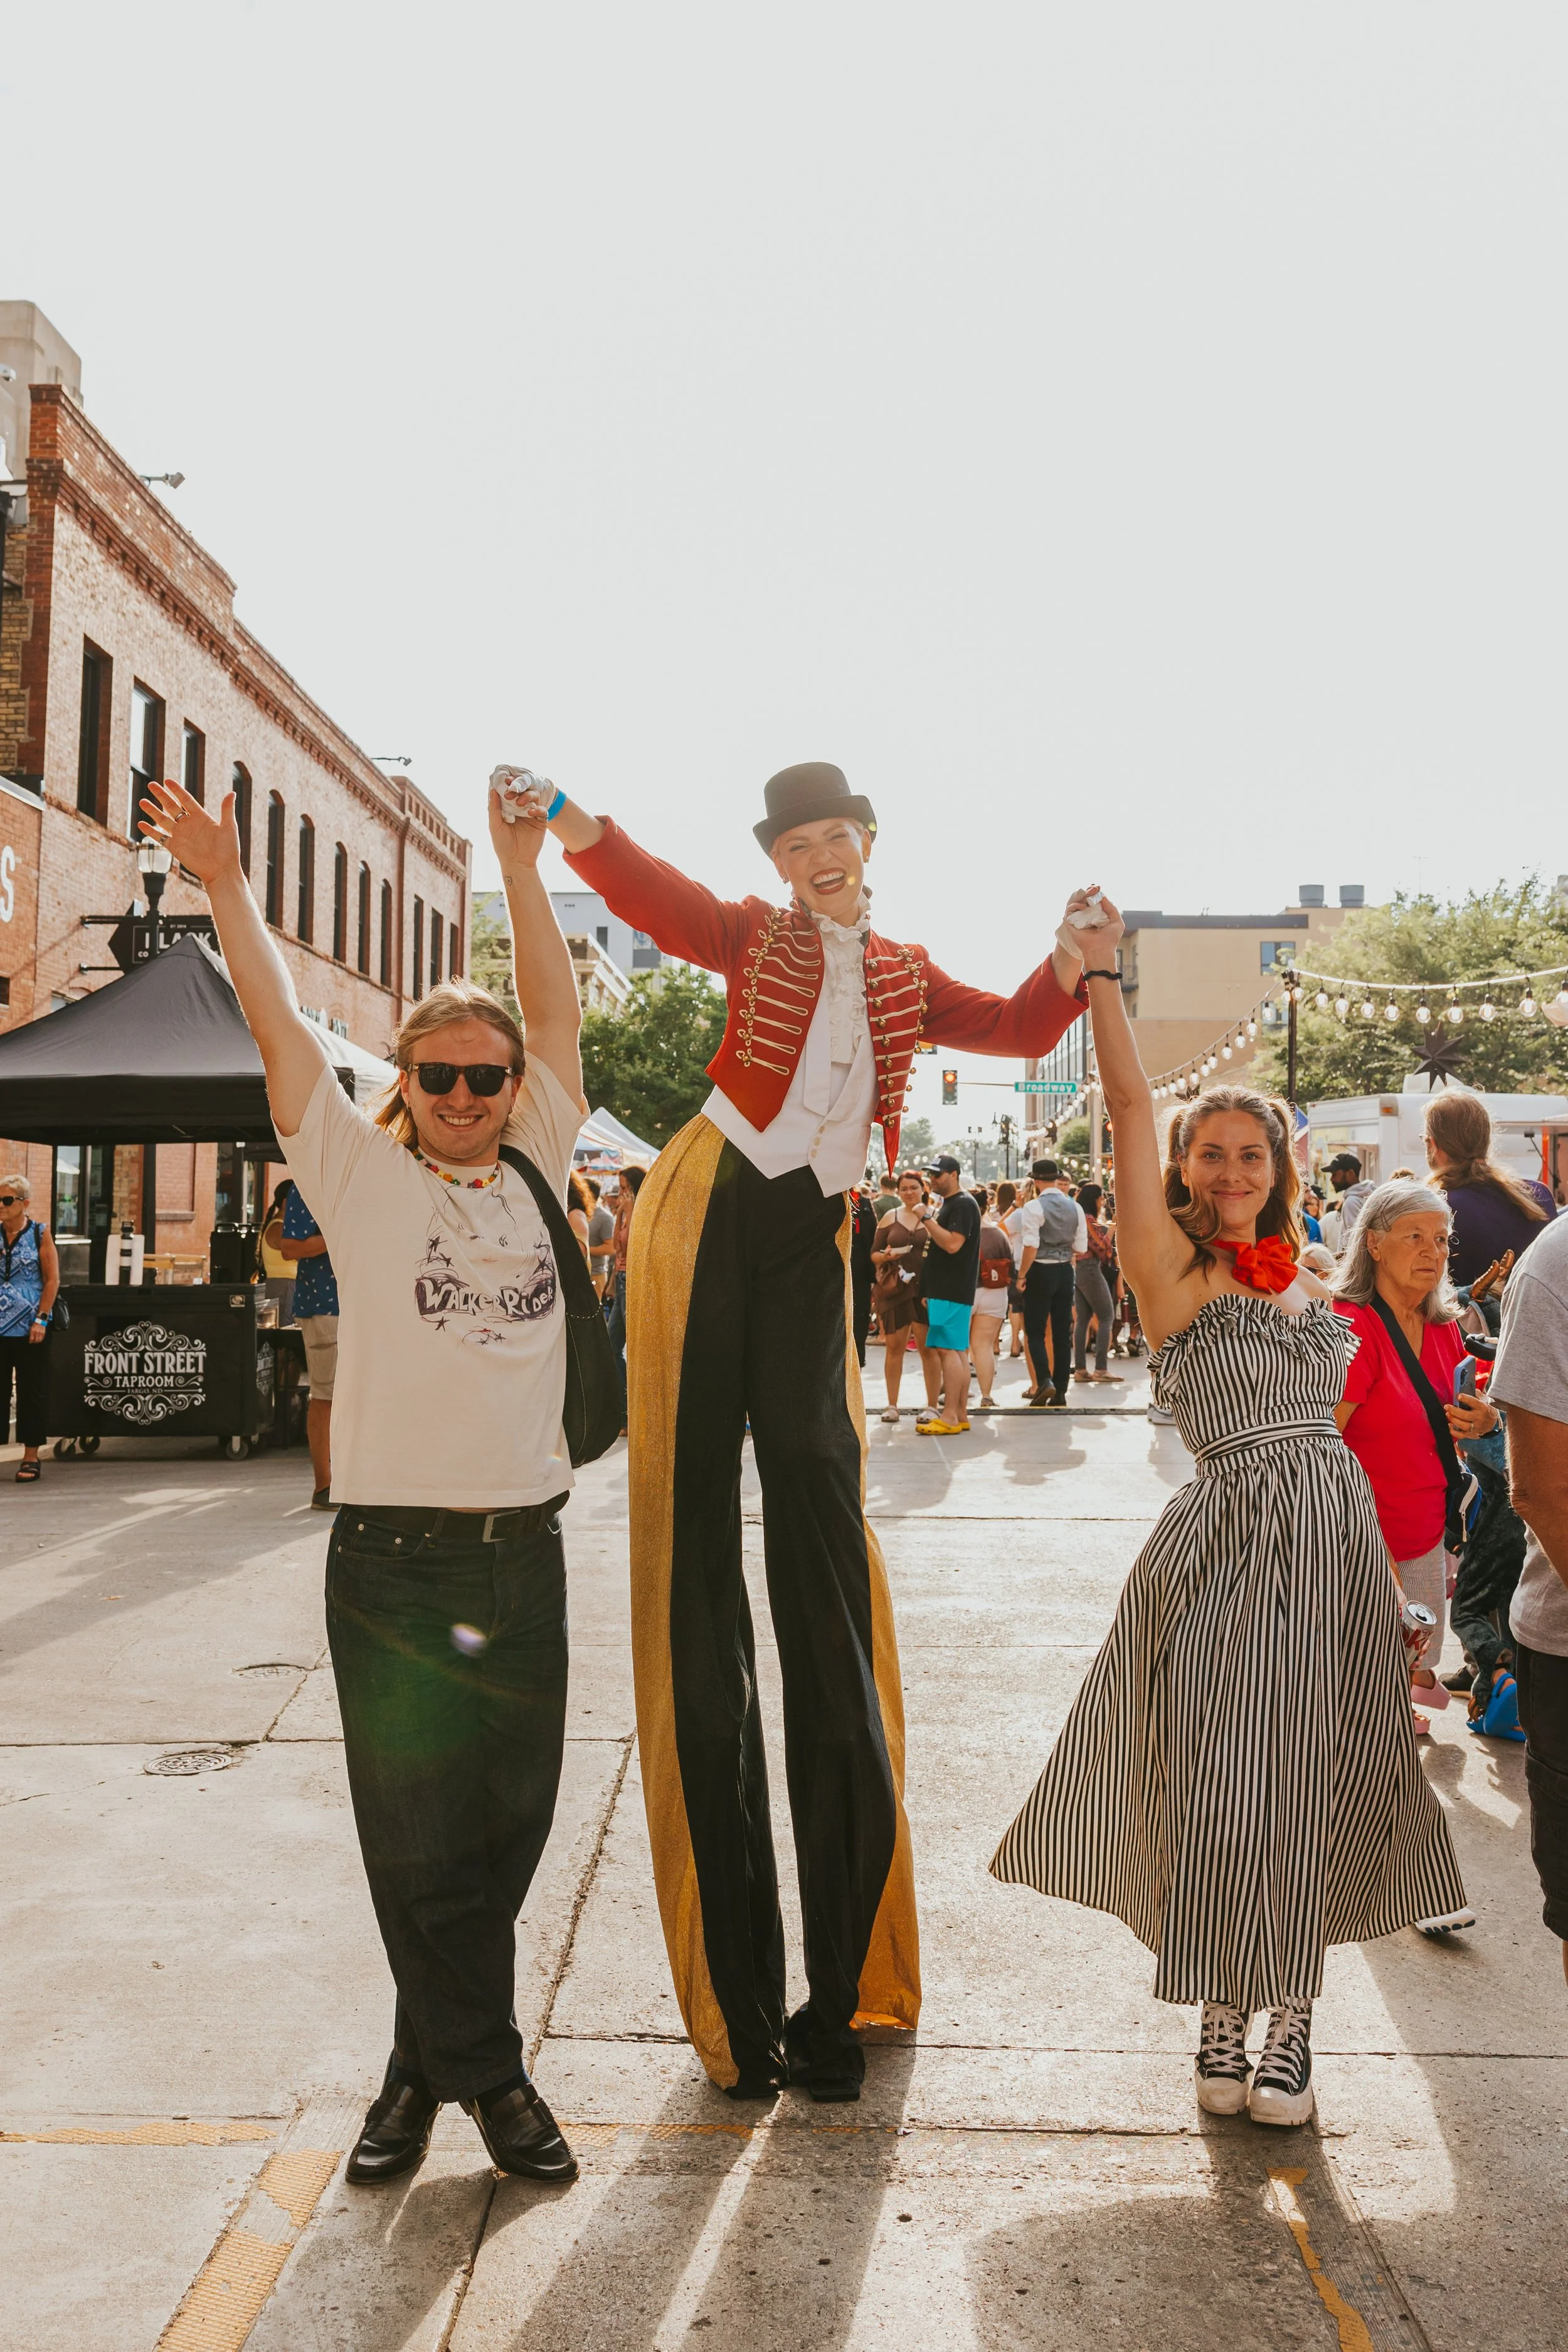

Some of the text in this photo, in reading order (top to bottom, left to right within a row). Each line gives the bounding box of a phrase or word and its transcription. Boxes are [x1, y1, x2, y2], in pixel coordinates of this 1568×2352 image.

[145, 932, 211, 949] LAK
[1018, 1083, 1073, 1094] Broadway
[84, 1352, 207, 1374] FRONT STREET
[114, 1376, 174, 1387] TAPROOM
